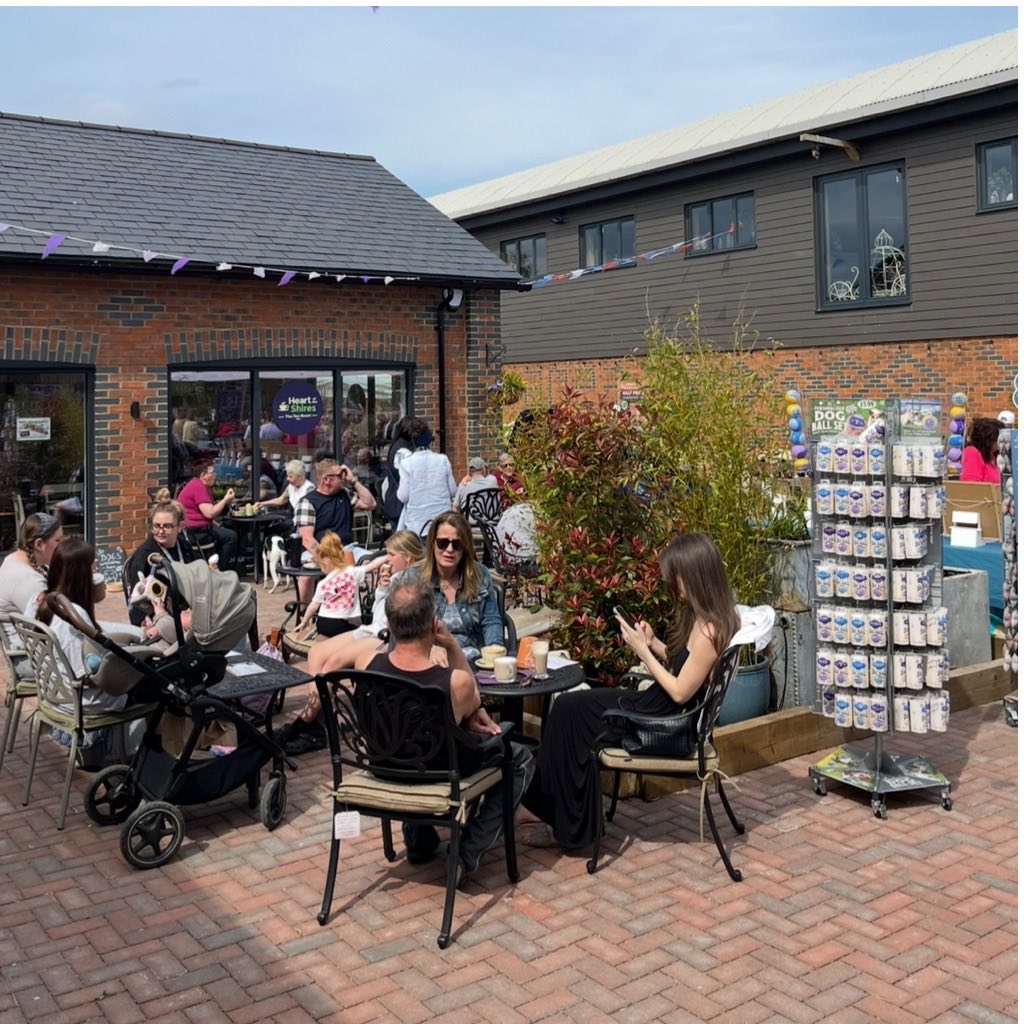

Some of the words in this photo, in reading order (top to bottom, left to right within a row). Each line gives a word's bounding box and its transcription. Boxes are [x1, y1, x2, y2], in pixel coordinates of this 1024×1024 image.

[288, 396, 312, 405] Heart
[290, 404, 317, 413] Shires
[814, 410, 846, 422] DOG
[811, 421, 833, 432] BALL
